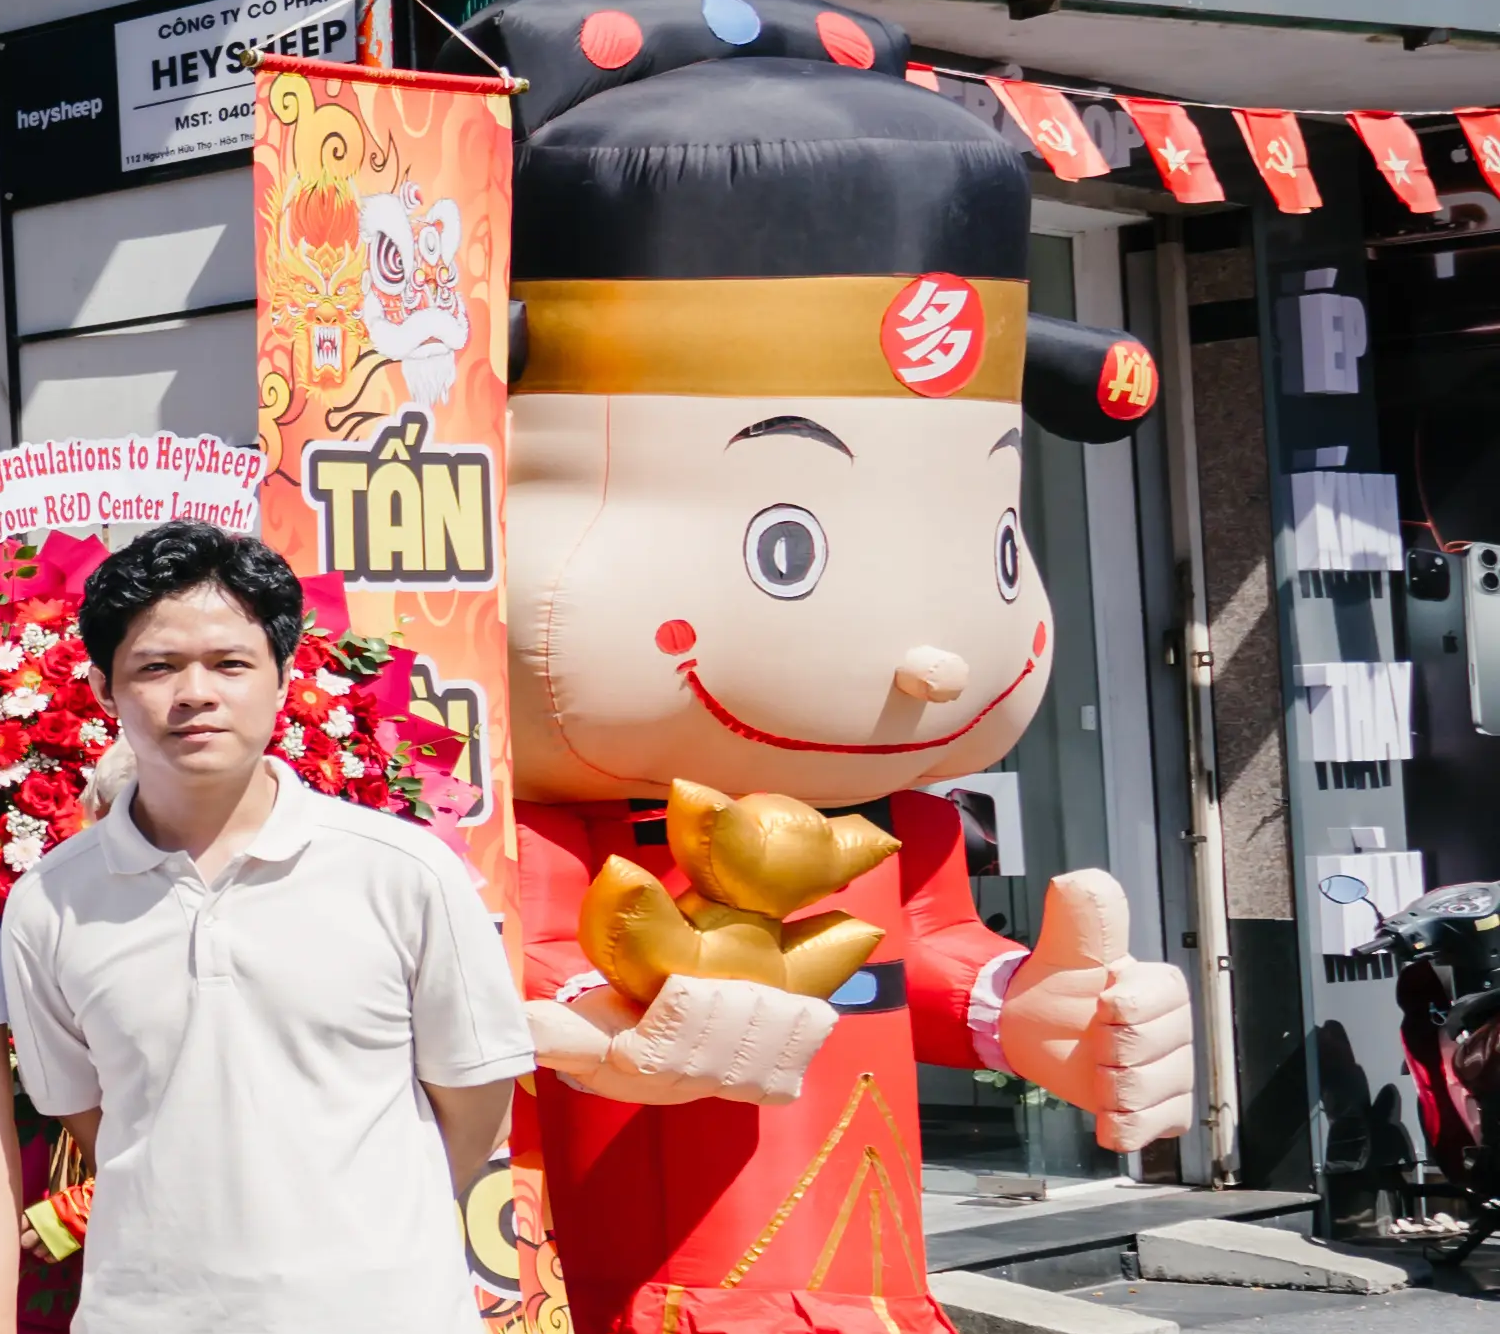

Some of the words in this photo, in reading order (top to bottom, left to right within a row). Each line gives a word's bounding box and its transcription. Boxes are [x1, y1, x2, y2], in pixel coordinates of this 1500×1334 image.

[158, 17, 216, 40] CÔNG
[220, 8, 240, 26] TY
[17, 97, 103, 130] heysheep
[175, 110, 213, 132] MST:
[125, 154, 141, 165] 112
[895, 279, 973, 383] 多
[128, 439, 149, 470] to
[155, 436, 262, 489] HeySheep
[44, 492, 92, 525] R&D
[98, 490, 165, 521] Center
[171, 490, 253, 531] Launch!
[314, 419, 492, 576] TẤN
